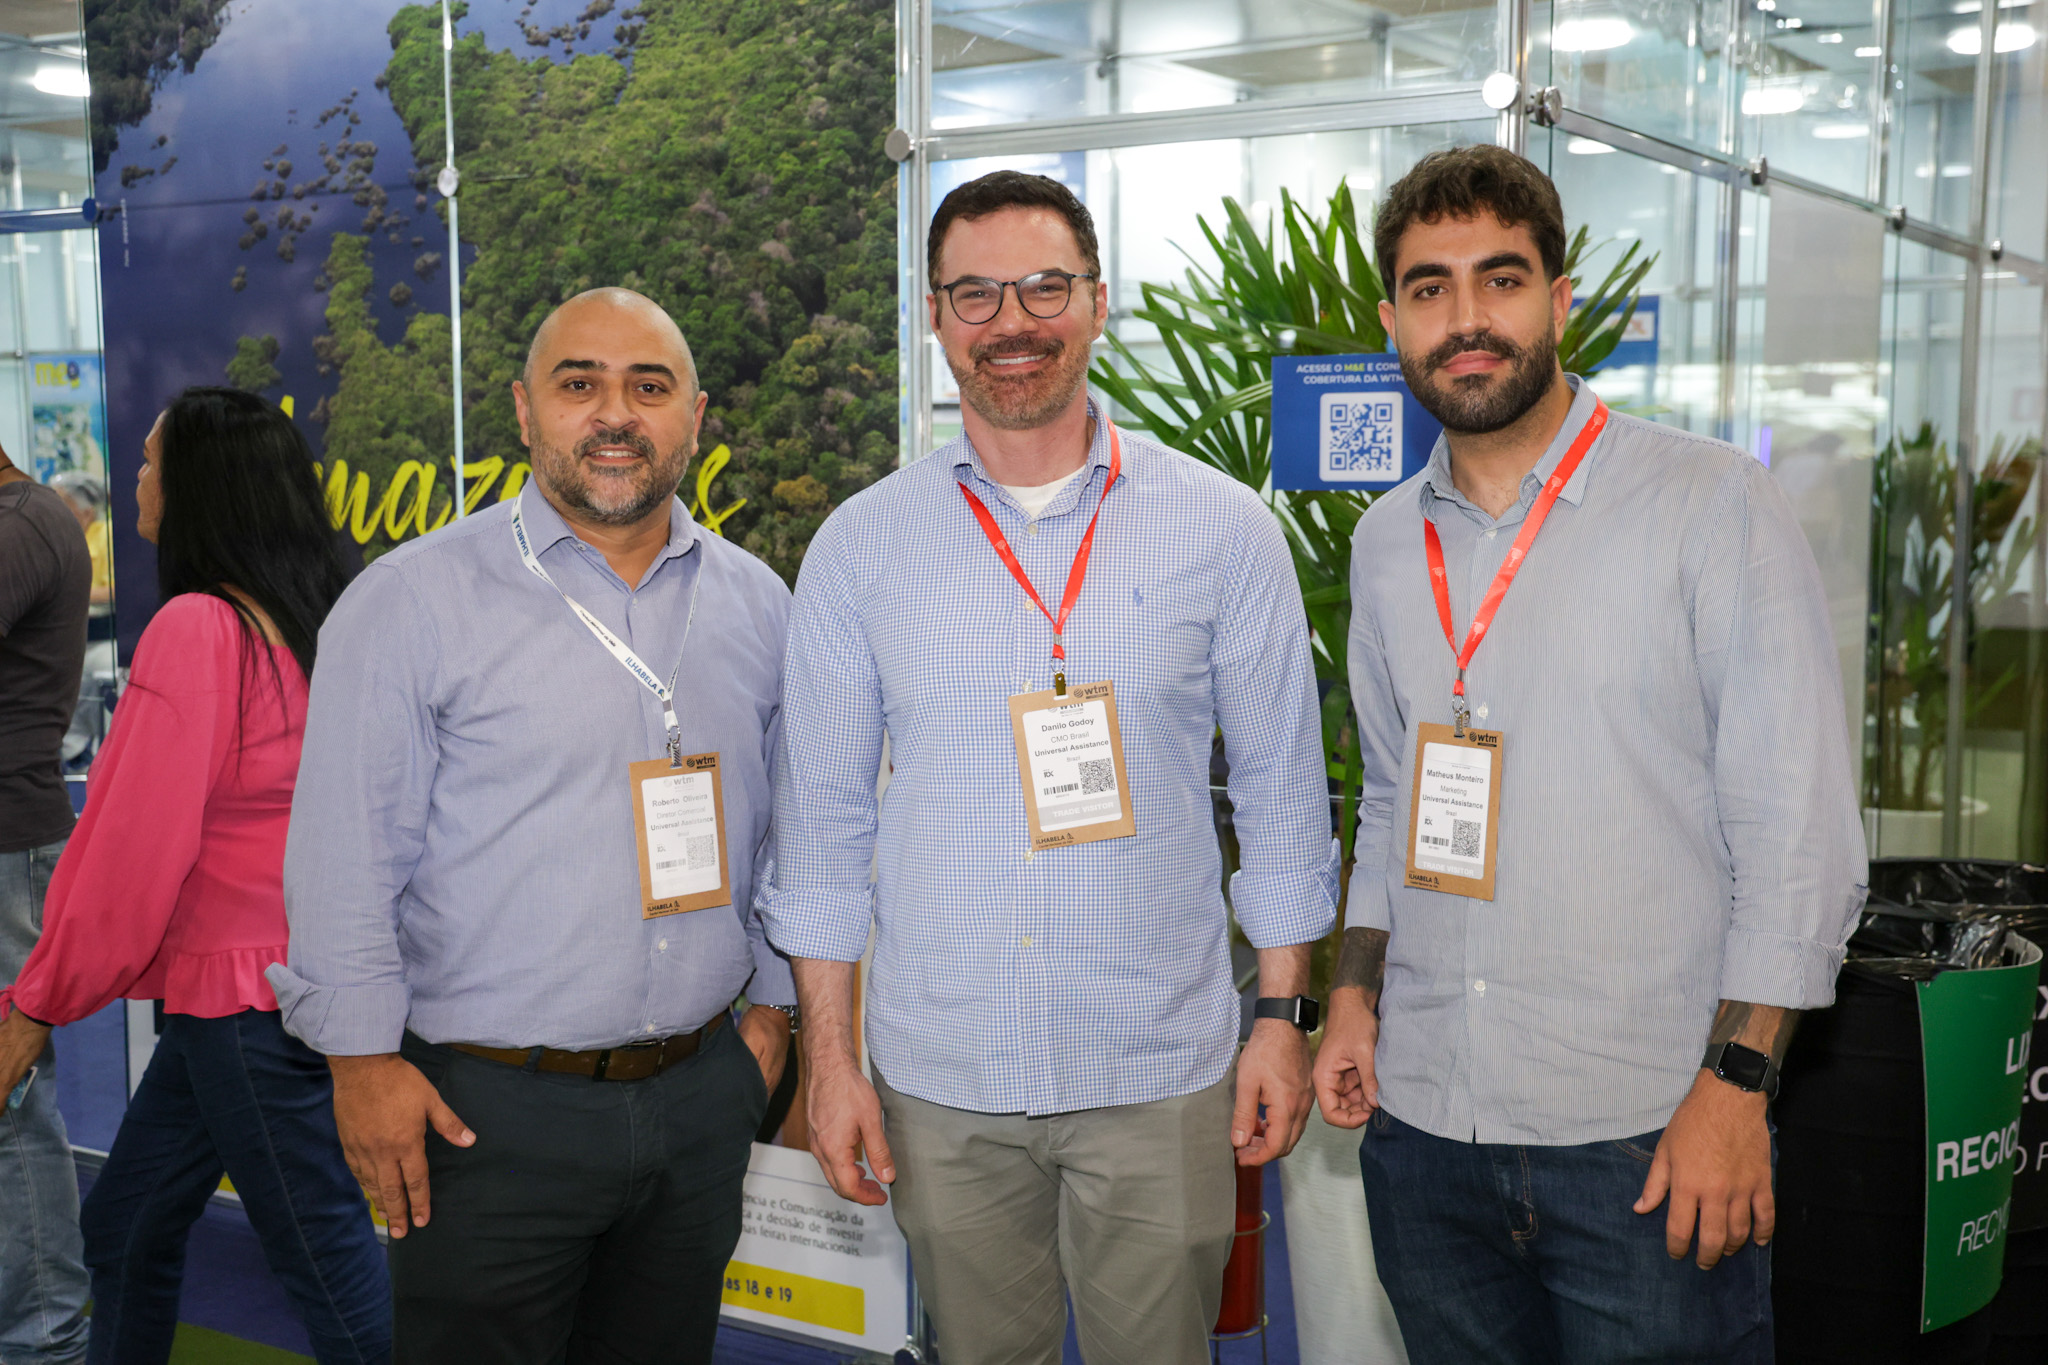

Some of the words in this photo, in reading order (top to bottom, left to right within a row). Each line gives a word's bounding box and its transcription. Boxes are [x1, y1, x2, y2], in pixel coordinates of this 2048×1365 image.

[1296, 363, 1332, 373] ACESSE
[1334, 363, 1342, 372] O
[1367, 362, 1373, 372] E
[1303, 374, 1361, 384] COBERTURA
[1364, 374, 1379, 383] DA
[515, 522, 530, 557] ILHABELA
[624, 656, 658, 690] ILHABELA
[1084, 685, 1108, 695] wtm
[1041, 722, 1067, 732] Danilo
[1068, 718, 1095, 728] Godoy
[1050, 734, 1069, 743] CMO
[1070, 731, 1090, 740] Brasil
[1477, 733, 1498, 743] wtm
[1034, 746, 1069, 757] Universal
[1070, 740, 1109, 751] Assistance
[695, 756, 716, 766] wtm
[673, 776, 694, 785] wtm
[1426, 769, 1454, 780] Matheus
[1455, 773, 1484, 784] Monteiro
[1440, 785, 1467, 797] Marketing
[652, 798, 680, 807] Roberto
[682, 794, 708, 803] Oliveira
[1422, 794, 1450, 805] Universal
[1450, 798, 1483, 809] Assistance
[1053, 807, 1081, 818] TRADE
[1082, 802, 1115, 813] VISITOR
[650, 821, 680, 831] Universal
[1036, 835, 1066, 845] ILHABELA
[1423, 861, 1446, 873] TRADE
[1446, 865, 1475, 877] VISITOR
[1408, 873, 1433, 883] ILHABELA
[647, 903, 673, 912] ILHABELA
[780, 1198, 848, 1223] Comunicação
[850, 1213, 864, 1226] da
[756, 1211, 762, 1221] a
[767, 1212, 805, 1230] decisão
[808, 1221, 821, 1233] de
[826, 1226, 865, 1242] investir
[760, 1225, 787, 1241] feiras
[746, 1279, 759, 1296] 18
[765, 1286, 773, 1299] e
[779, 1286, 792, 1303] 19
